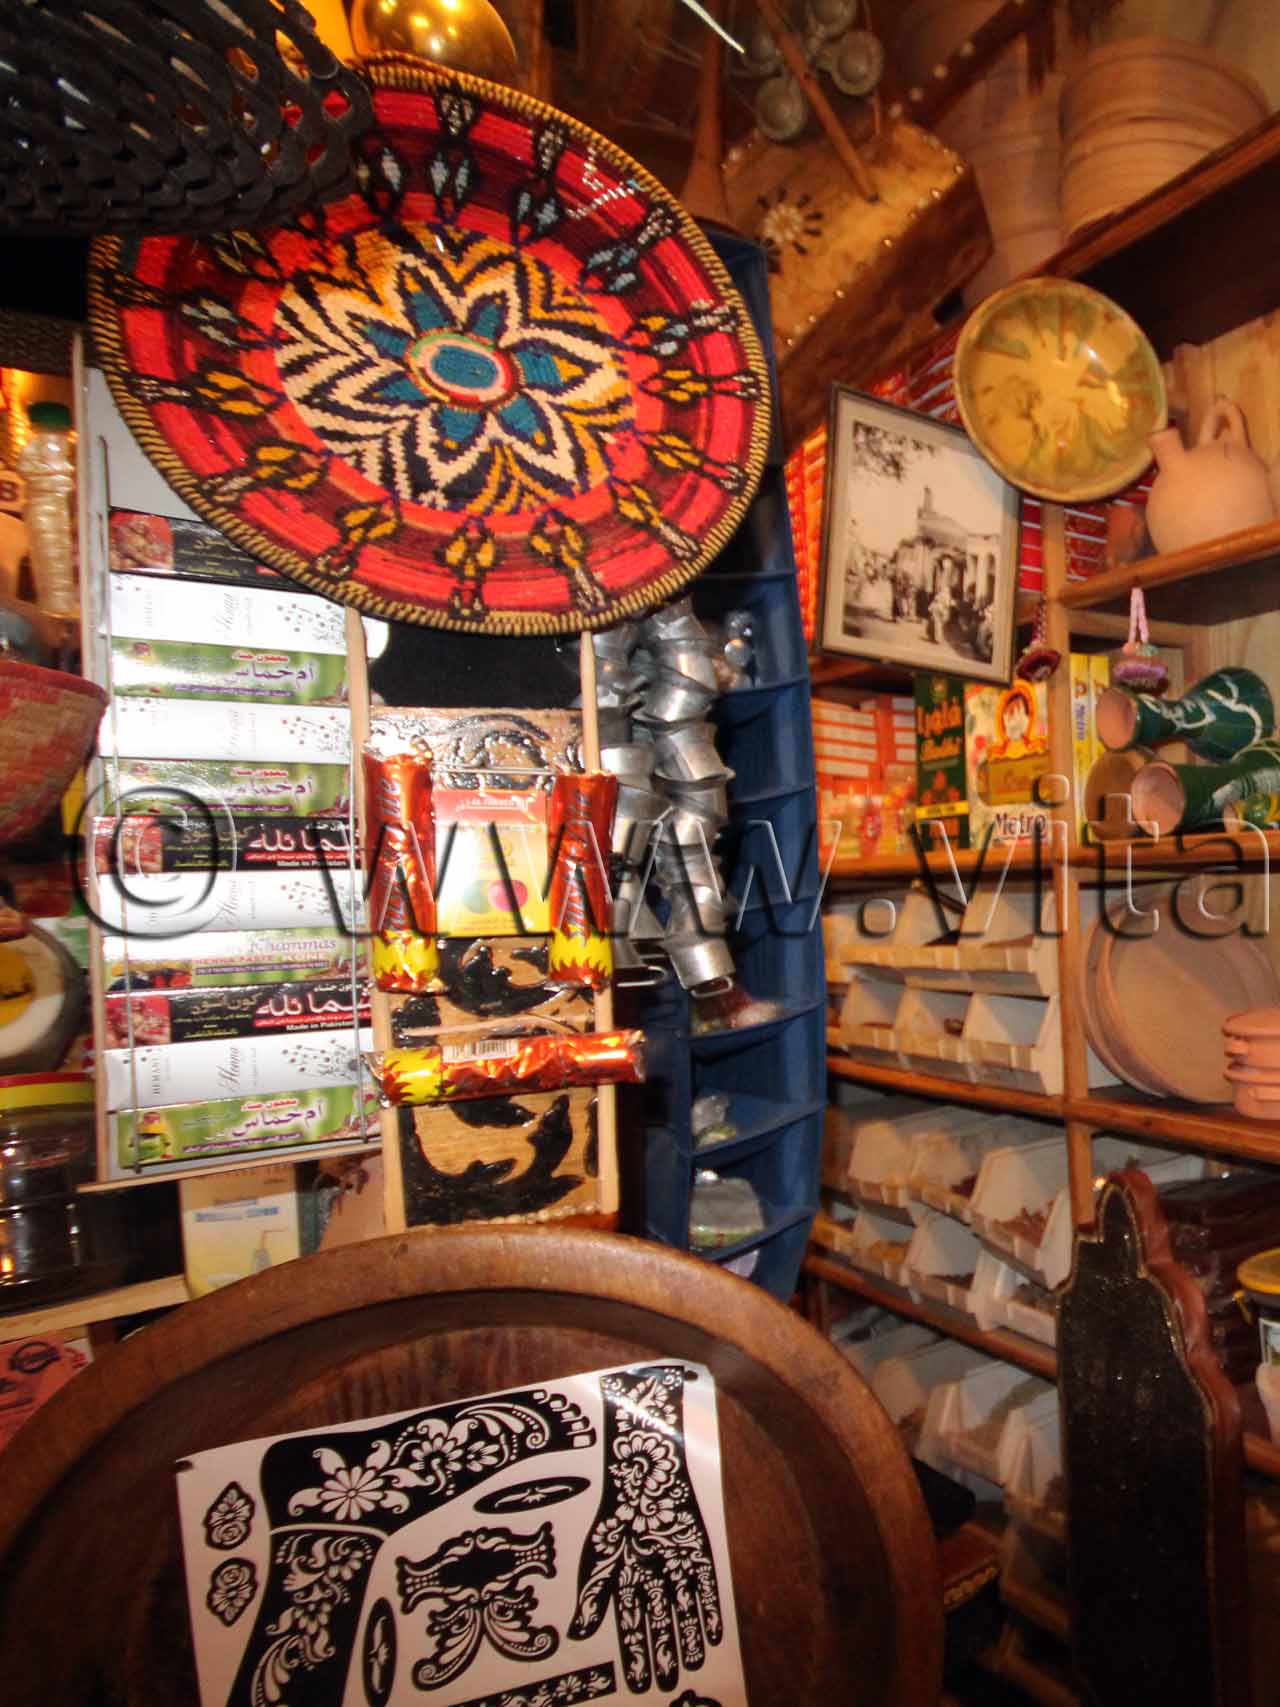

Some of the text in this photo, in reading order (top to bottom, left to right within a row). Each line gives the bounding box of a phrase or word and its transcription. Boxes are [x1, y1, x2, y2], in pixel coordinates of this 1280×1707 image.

[996, 812, 1047, 838] Metro
[312, 859, 347, 867] Pistan
[285, 1023, 309, 1031] Made
[310, 1022, 320, 1030] in
